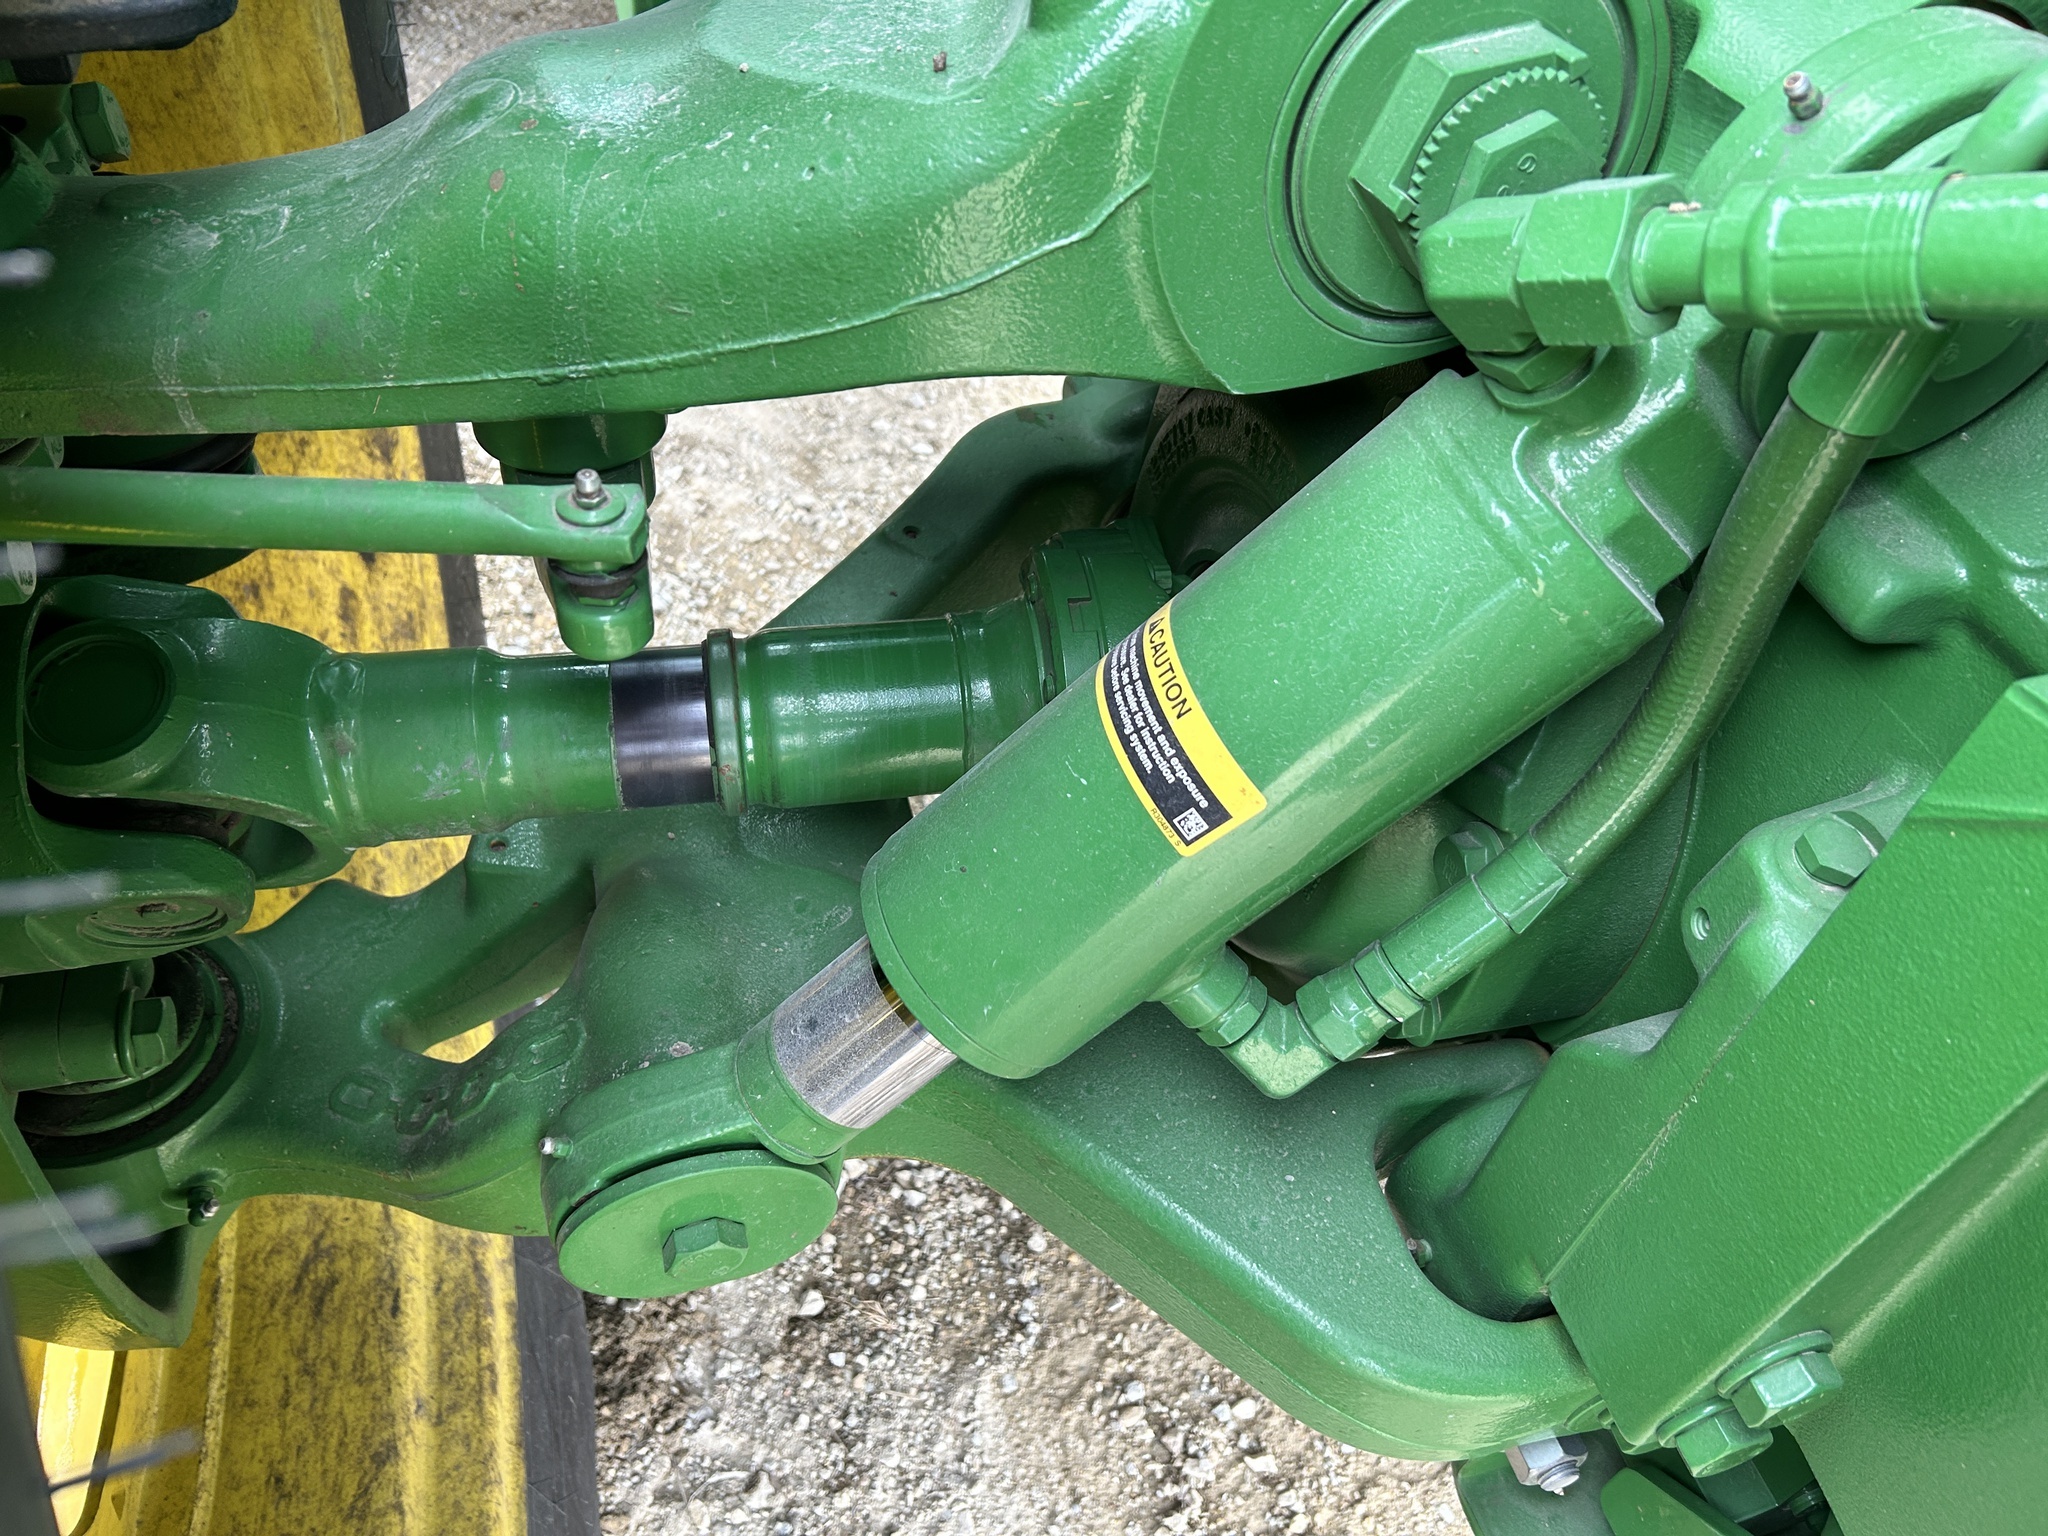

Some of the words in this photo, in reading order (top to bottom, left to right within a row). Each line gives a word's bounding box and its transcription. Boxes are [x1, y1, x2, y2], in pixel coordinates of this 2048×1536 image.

[1110, 664, 1120, 692] before
[1120, 666, 1130, 686] See
[1129, 645, 1140, 681] machine
[1149, 628, 1193, 720] CAUTION
[1114, 690, 1135, 735] servicing
[1124, 683, 1140, 713] dealer
[1134, 679, 1164, 735] movement
[1133, 711, 1146, 728] for
[1129, 732, 1153, 775] system.
[1140, 726, 1176, 784] instruction
[1156, 733, 1176, 758] and
[1170, 756, 1209, 809] exposure
